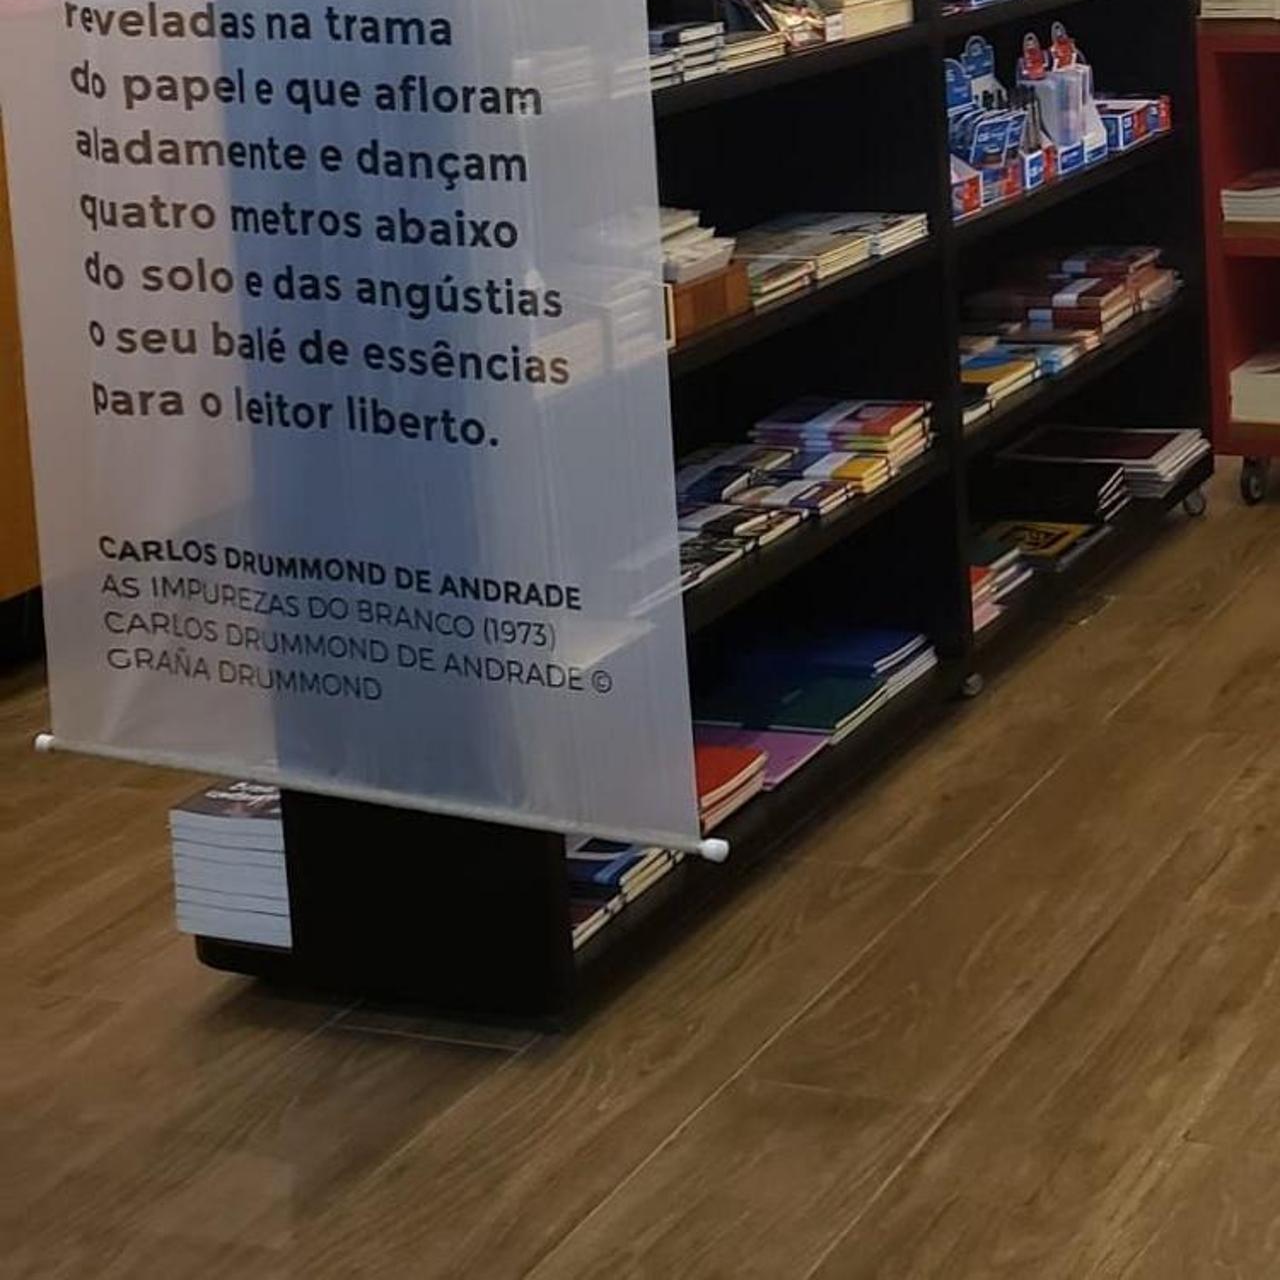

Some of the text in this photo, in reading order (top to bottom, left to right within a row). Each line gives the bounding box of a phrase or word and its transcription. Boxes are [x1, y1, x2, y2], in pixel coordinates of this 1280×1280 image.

[266, 12, 311, 39] na
[325, 6, 452, 46] trama
[70, 61, 542, 116] do papel e que afloram
[75, 125, 528, 190] aladamente e dançam
[80, 192, 519, 249] quatro metros abaixo
[85, 252, 563, 320] do solo e das angústias
[89, 320, 570, 385] o seu balé de essências
[92, 381, 499, 447] para o leitor liberto.
[100, 535, 582, 610] CARLOS DRUMMOND DE ANDRADE
[102, 575, 557, 651] AS IMPUREZAS DO BRANCO (1973)
[104, 612, 217, 642] CARLOS
[226, 622, 389, 663] DRUMMOND
[397, 644, 436, 672] DE
[444, 653, 585, 693] ANDRADE
[107, 647, 382, 700] GRAÑA DRUMMOND
